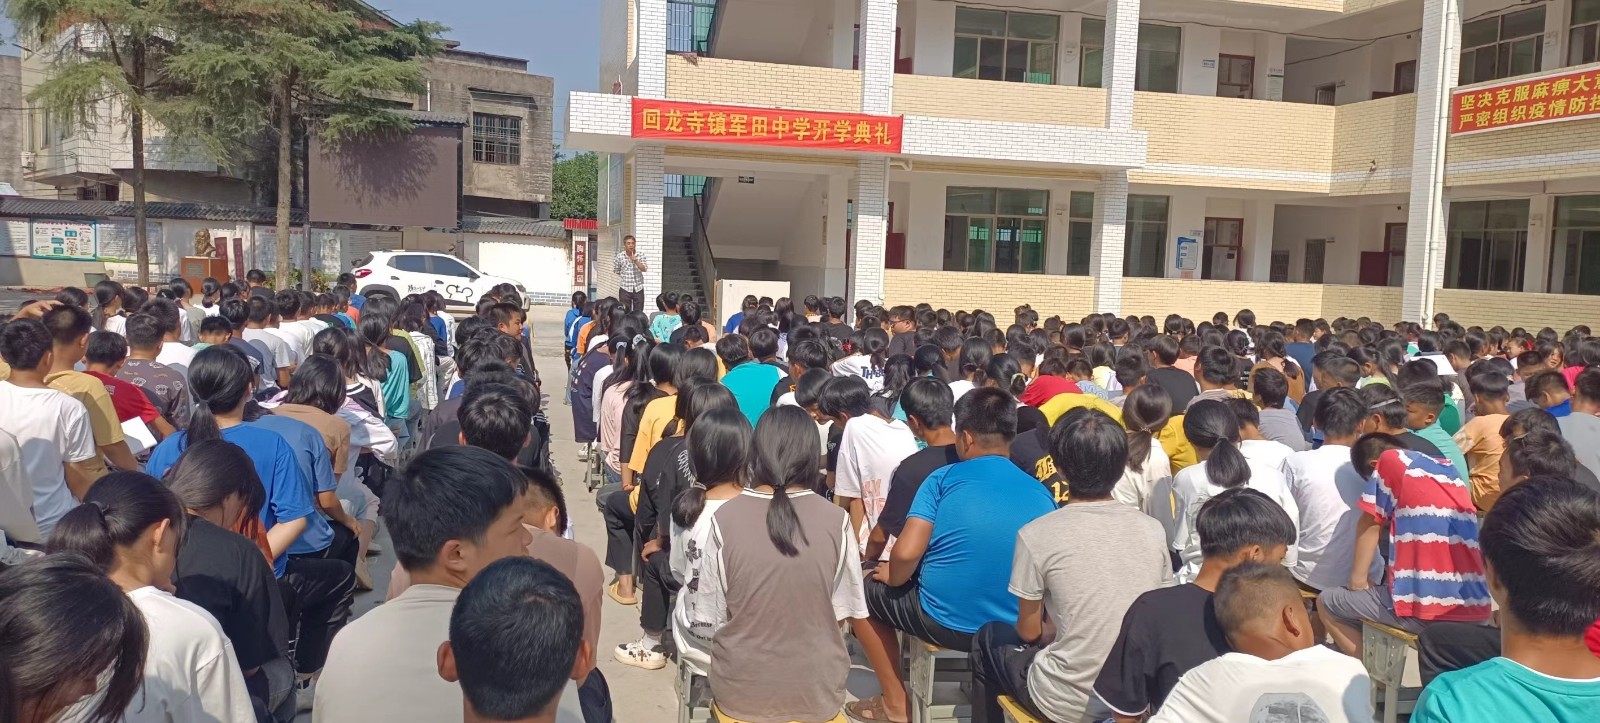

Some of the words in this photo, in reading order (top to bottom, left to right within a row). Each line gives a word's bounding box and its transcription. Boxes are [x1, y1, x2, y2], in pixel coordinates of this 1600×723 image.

[642, 107, 892, 145] 回龙寺镇军田中学开学典礼
